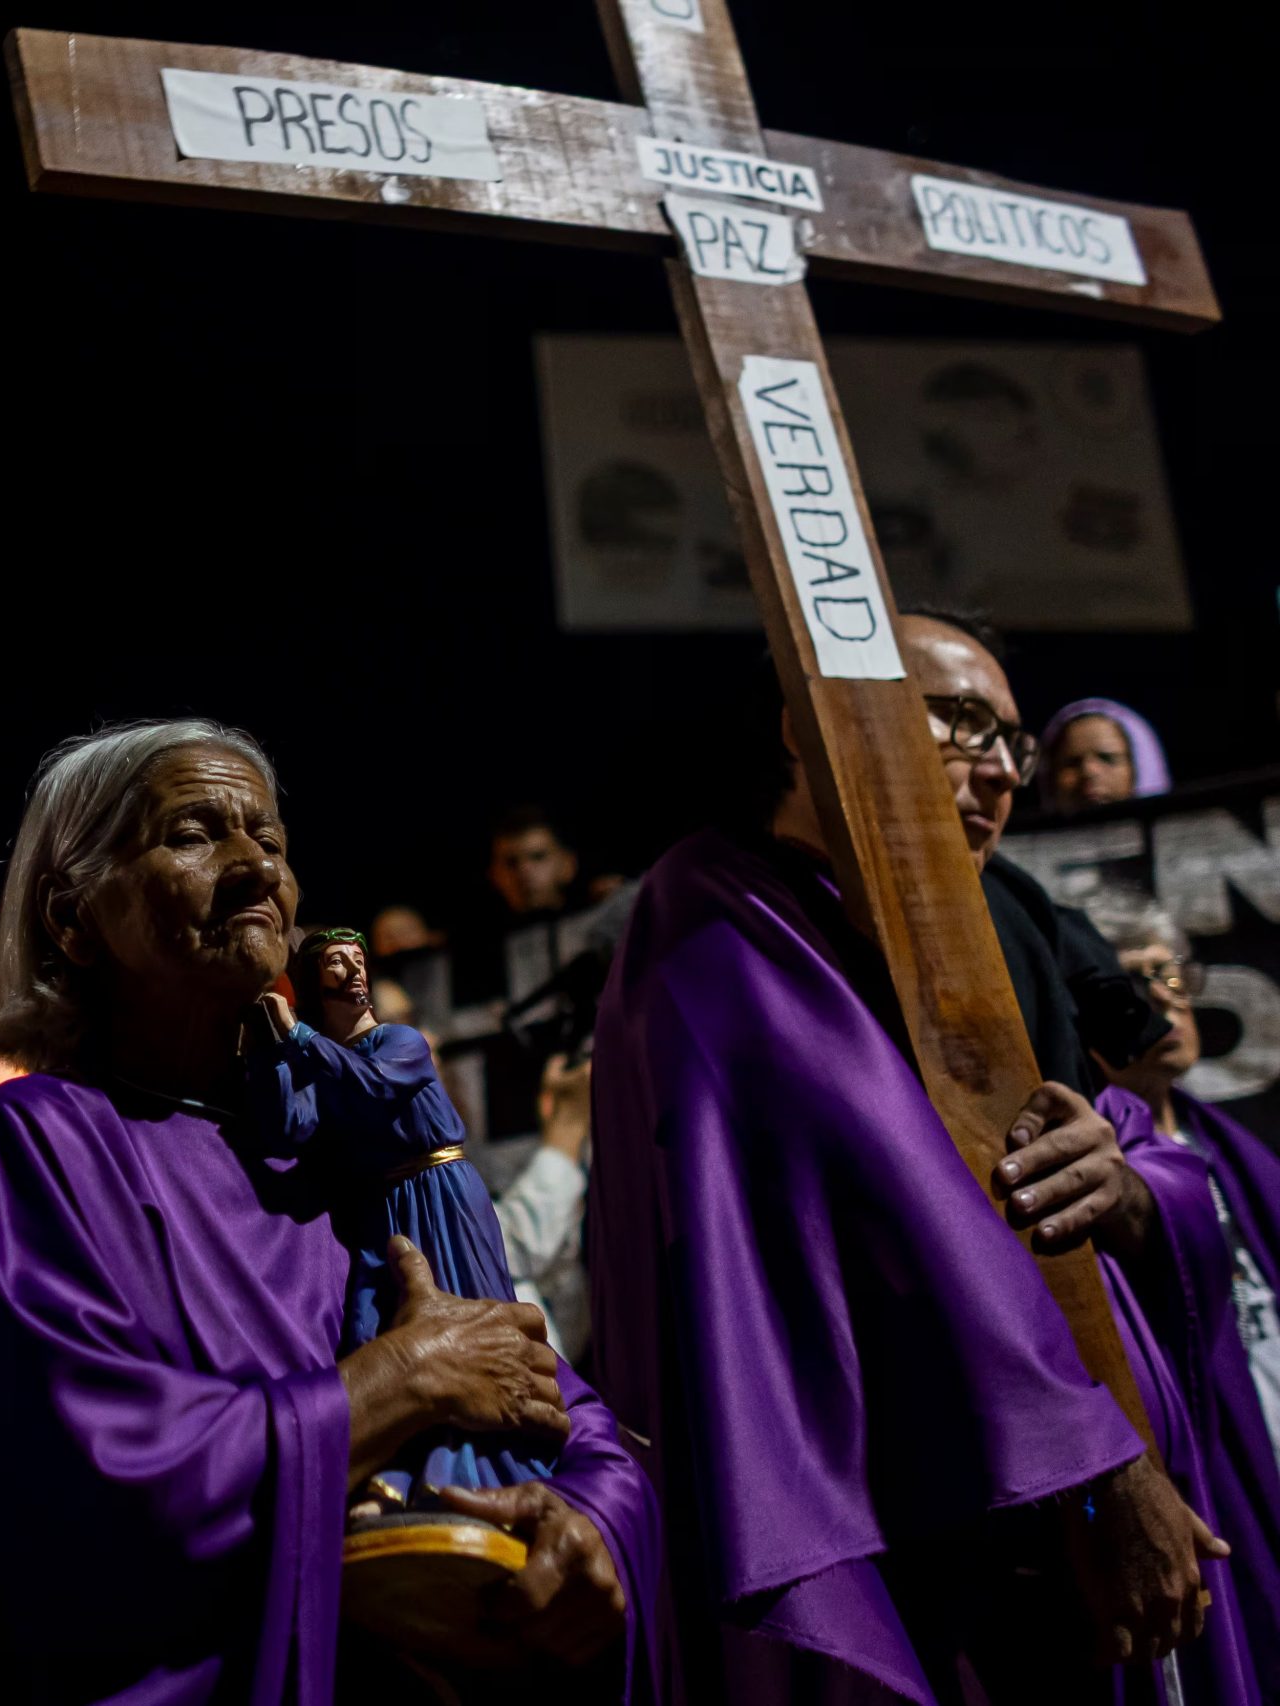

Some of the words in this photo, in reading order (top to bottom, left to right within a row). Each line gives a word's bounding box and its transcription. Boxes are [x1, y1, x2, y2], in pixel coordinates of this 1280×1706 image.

[233, 86, 432, 163] PRESOS
[655, 148, 814, 201] JUSTICIA
[688, 211, 787, 275] PAZ
[922, 186, 1112, 265] POLITICOS
[754, 379, 877, 642] VERDAD
